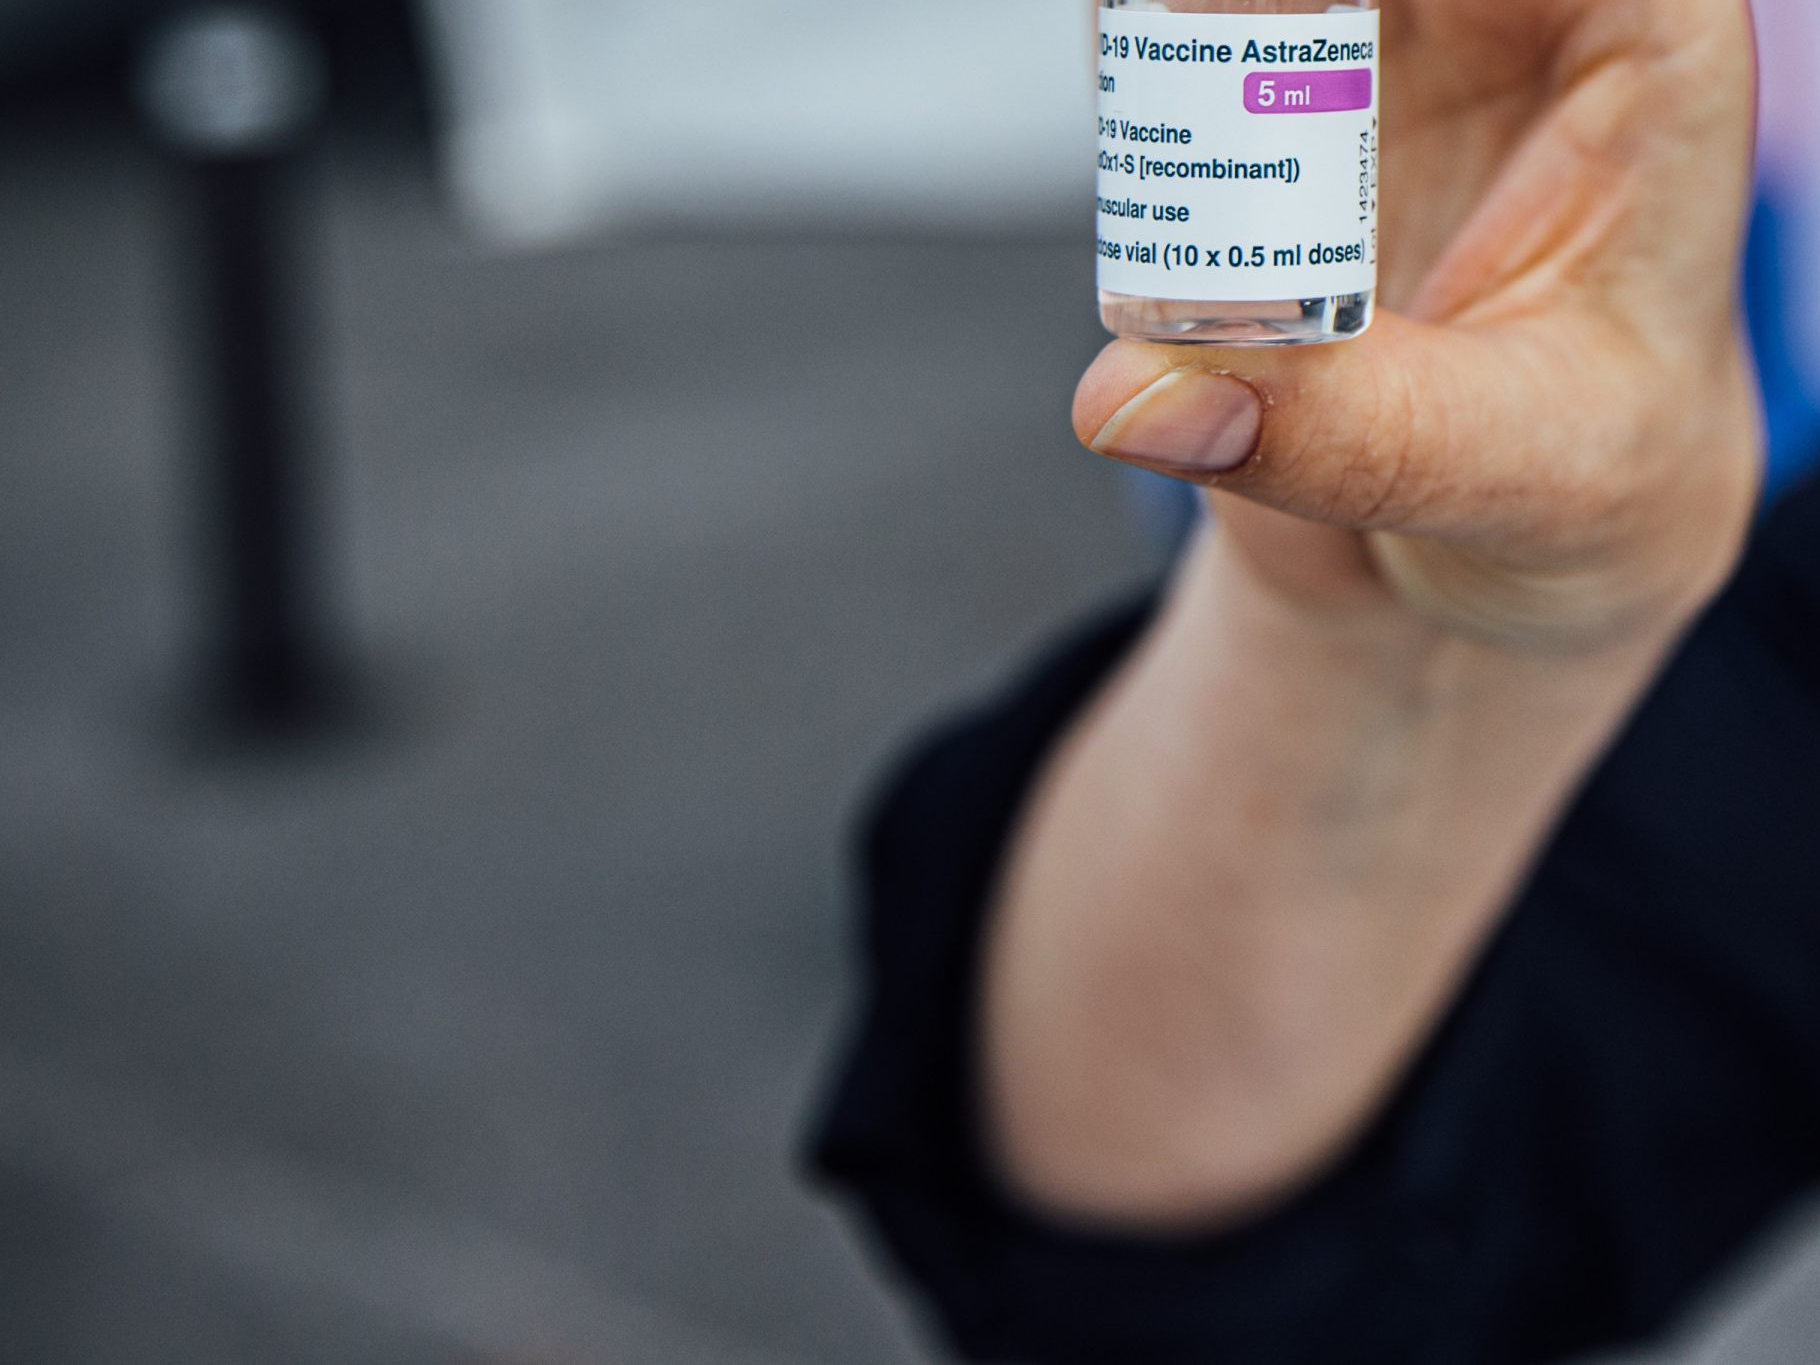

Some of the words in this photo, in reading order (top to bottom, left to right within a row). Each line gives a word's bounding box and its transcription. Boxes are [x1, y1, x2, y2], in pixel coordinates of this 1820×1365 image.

[1134, 36, 1232, 63] Vaccine
[1240, 38, 1374, 63] AstraZeneca
[1257, 80, 1276, 107] 5
[1284, 85, 1311, 106] ml
[1120, 120, 1192, 145] Vaccine
[1139, 155, 1300, 183] [recombinant])
[1359, 130, 1369, 223] 1423474
[1152, 208, 1190, 222] use
[1125, 242, 1157, 264] vial
[1163, 244, 1198, 271] (10
[1205, 250, 1221, 267] x
[1228, 246, 1265, 268] 0.5
[1273, 244, 1301, 266] ml
[1308, 238, 1366, 265] doses)
